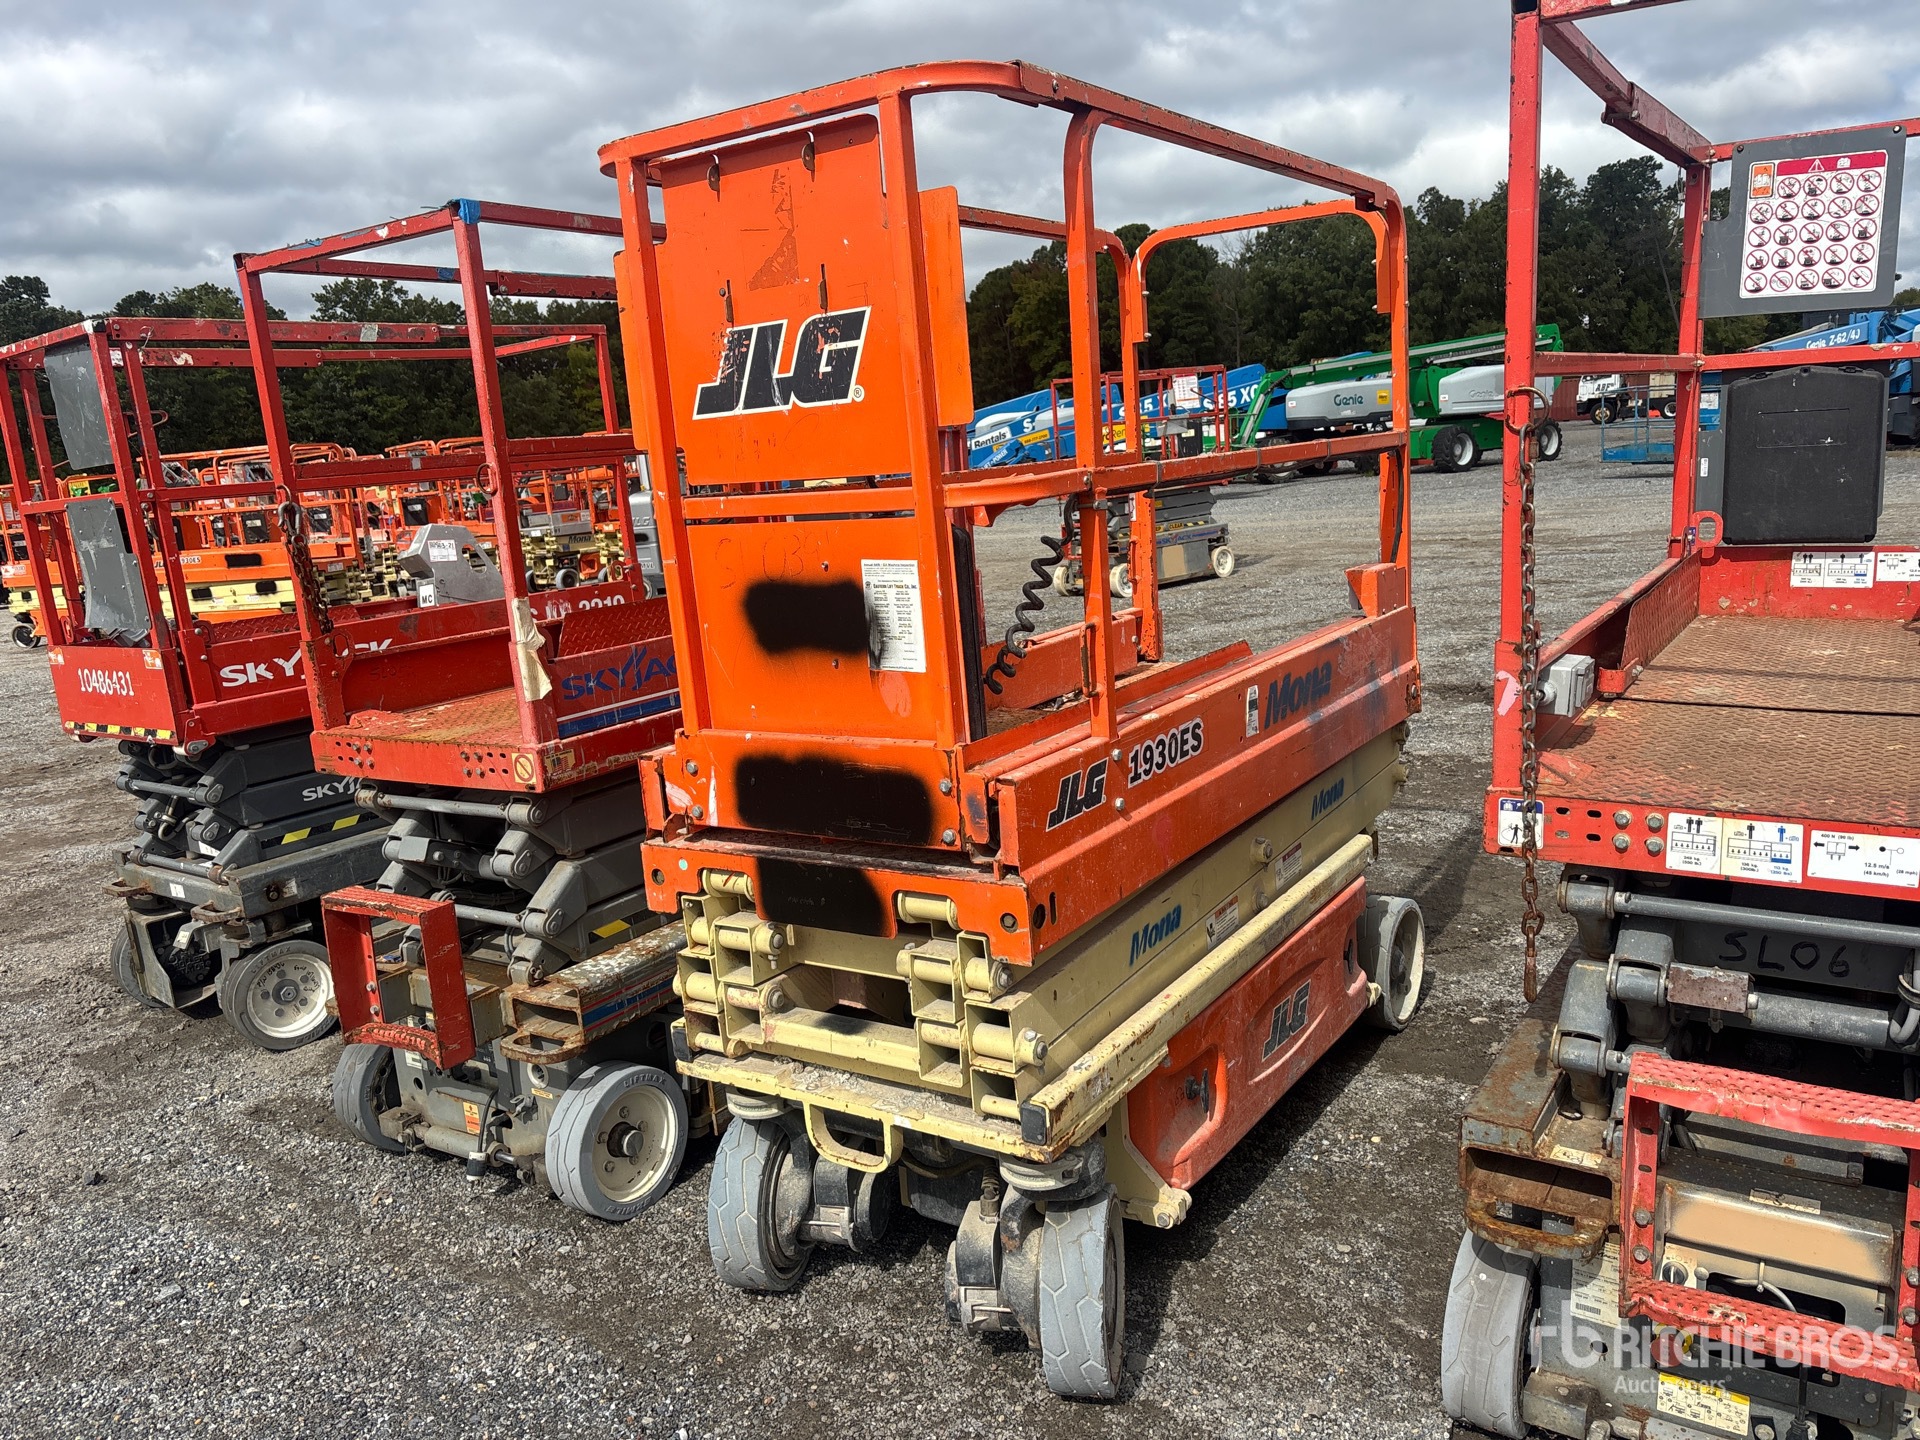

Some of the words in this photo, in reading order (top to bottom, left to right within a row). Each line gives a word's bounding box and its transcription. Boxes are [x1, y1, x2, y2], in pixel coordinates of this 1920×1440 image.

[693, 306, 872, 420] JLG
[1334, 394, 1363, 407] Genie
[974, 431, 1008, 449] Rentals
[568, 535, 592, 544] Mona
[421, 594, 433, 605] MC
[77, 667, 135, 697] 10486431
[1264, 661, 1332, 730] Mona
[1128, 718, 1203, 788] 1930ES
[1046, 758, 1108, 832] JLG
[1311, 778, 1344, 821] Mona
[1129, 903, 1182, 967] Mona
[1719, 931, 1850, 978] SL06
[251, 946, 291, 974] LIFTMAX
[1262, 978, 1311, 1063] JLG
[623, 1072, 667, 1088] LIFTMAX
